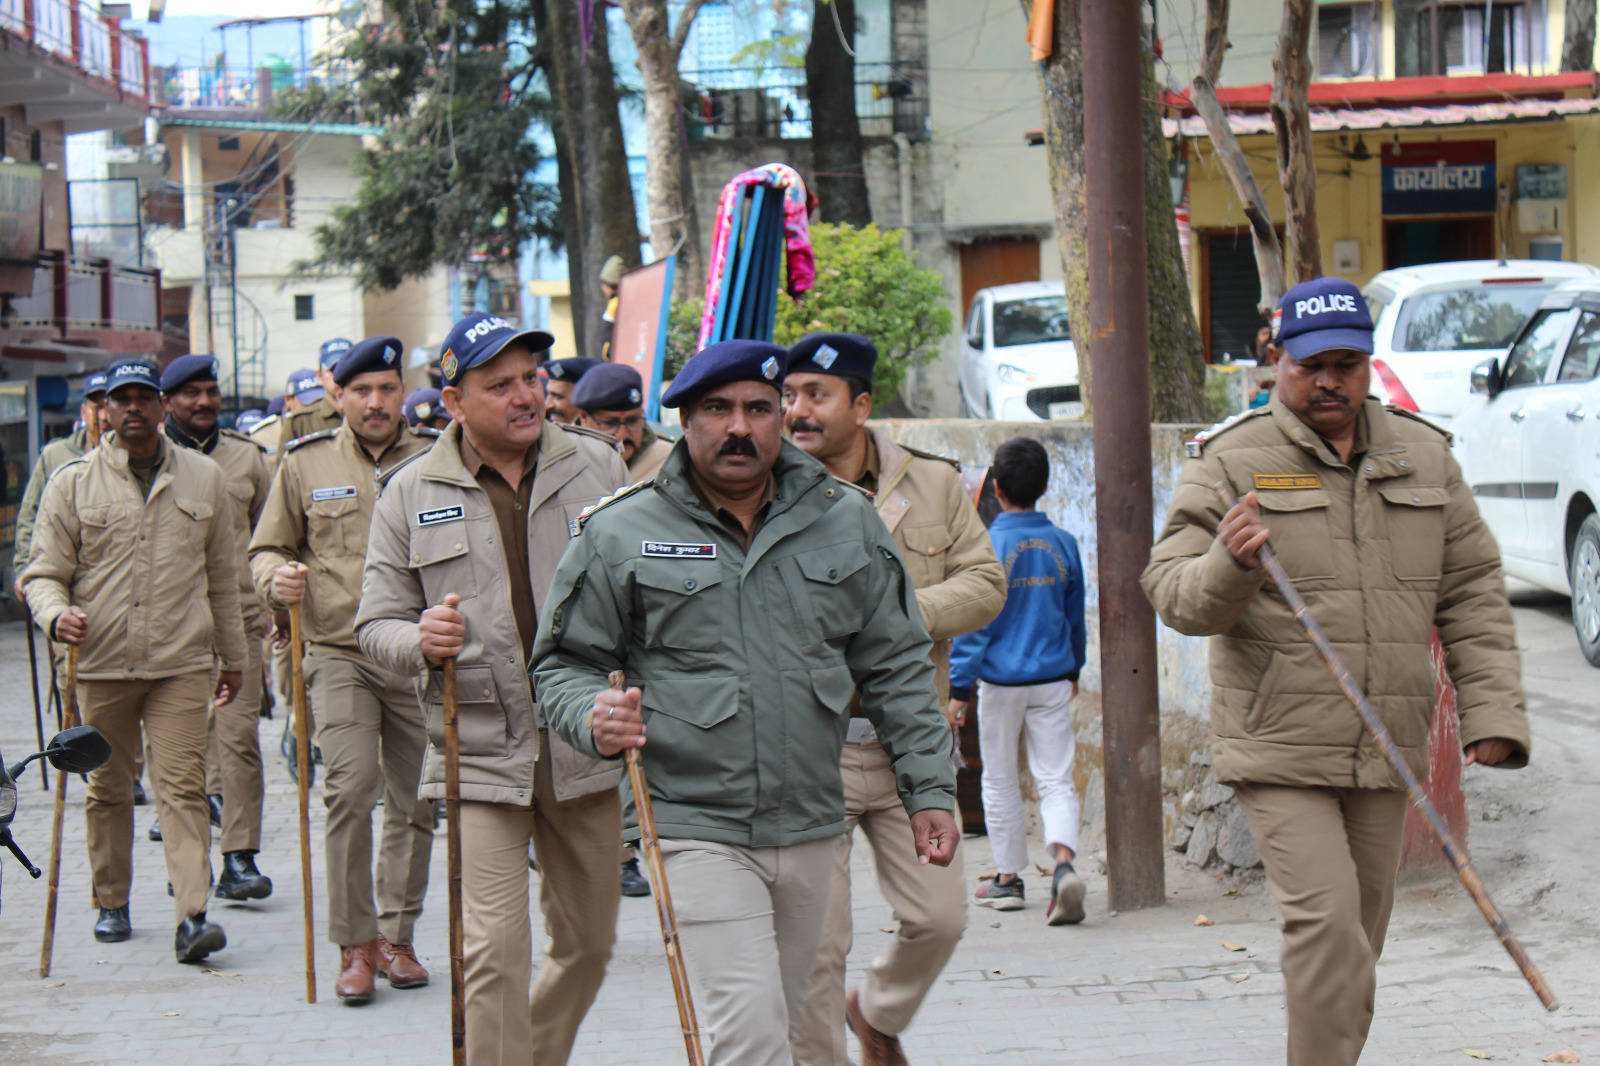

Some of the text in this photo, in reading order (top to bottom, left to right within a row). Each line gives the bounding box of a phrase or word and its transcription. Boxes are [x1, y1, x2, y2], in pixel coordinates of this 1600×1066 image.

[1393, 160, 1486, 191] कार्यालय
[1295, 293, 1358, 319] POLICE
[115, 364, 151, 377] POLICE
[675, 546, 701, 555] कुमार
